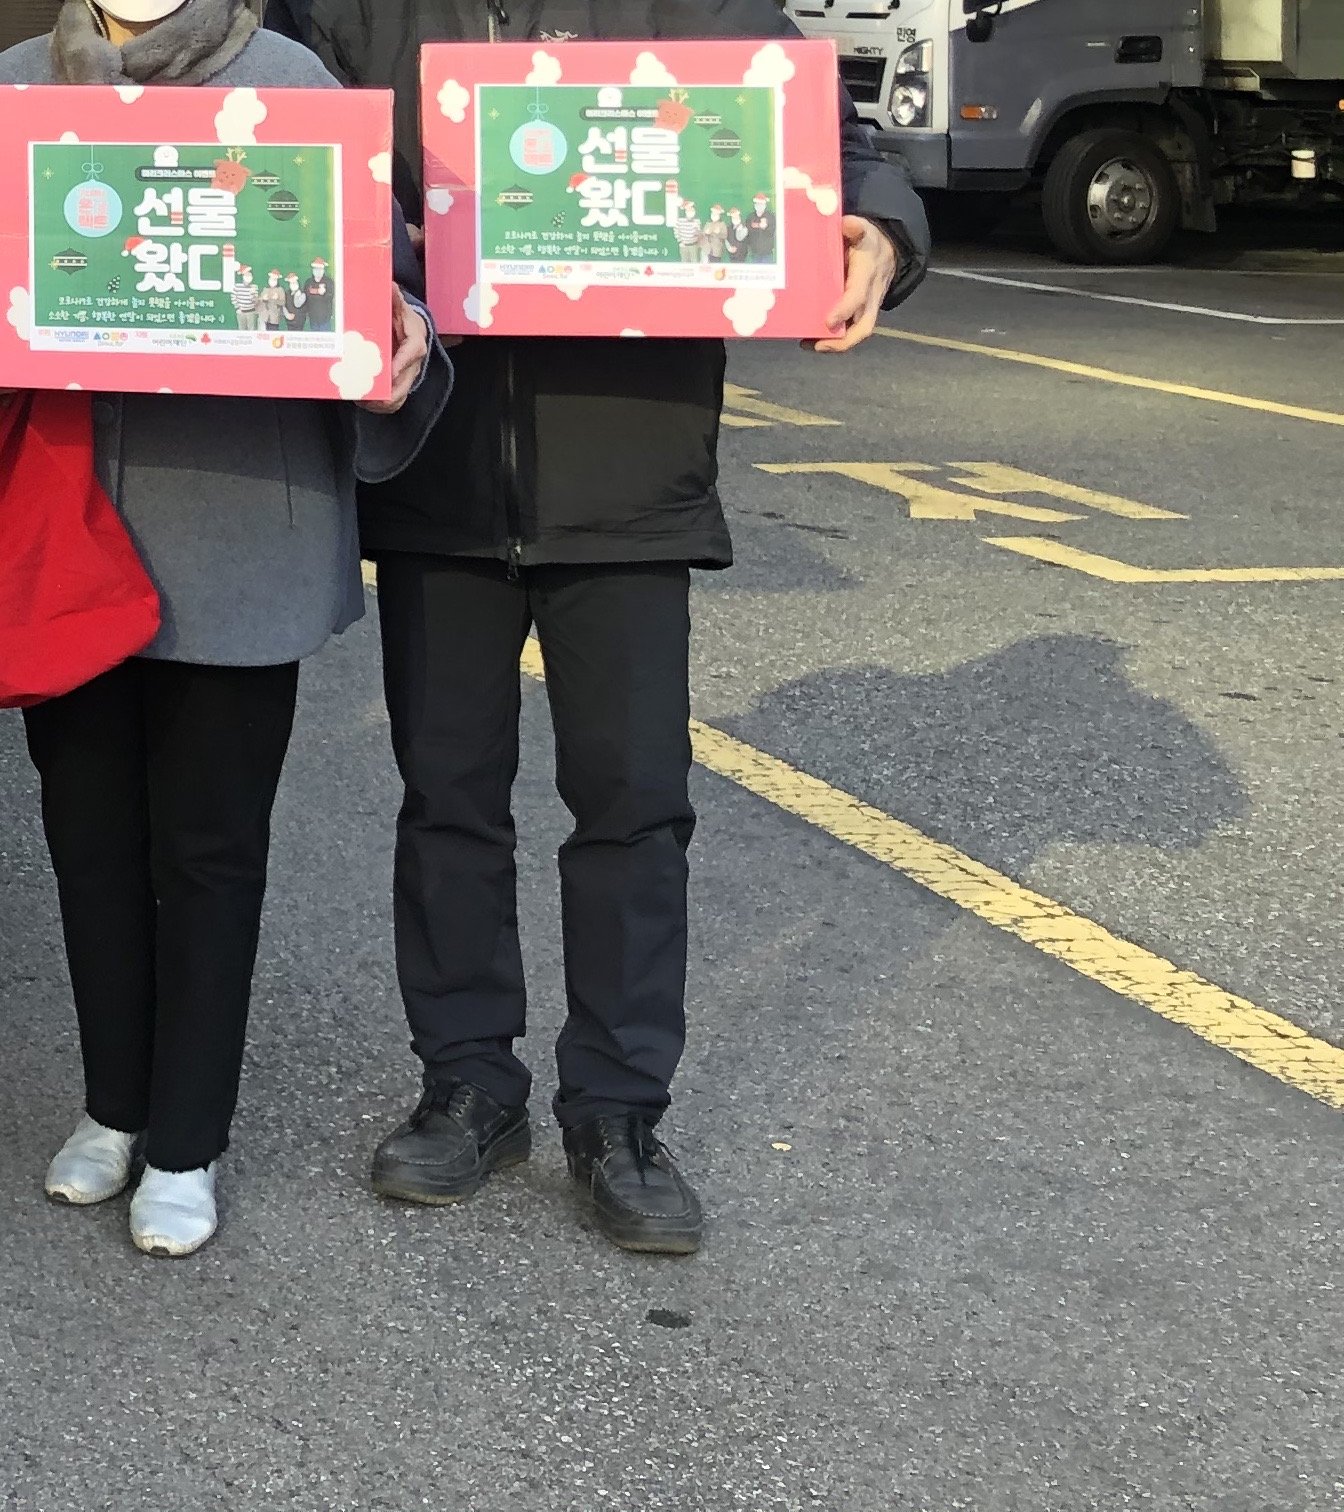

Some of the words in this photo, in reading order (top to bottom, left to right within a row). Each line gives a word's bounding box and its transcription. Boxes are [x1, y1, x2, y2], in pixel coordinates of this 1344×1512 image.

[577, 125, 680, 173] 선물
[133, 186, 237, 236] 선물
[577, 175, 683, 226] 왔다
[133, 238, 240, 292] 왔다
